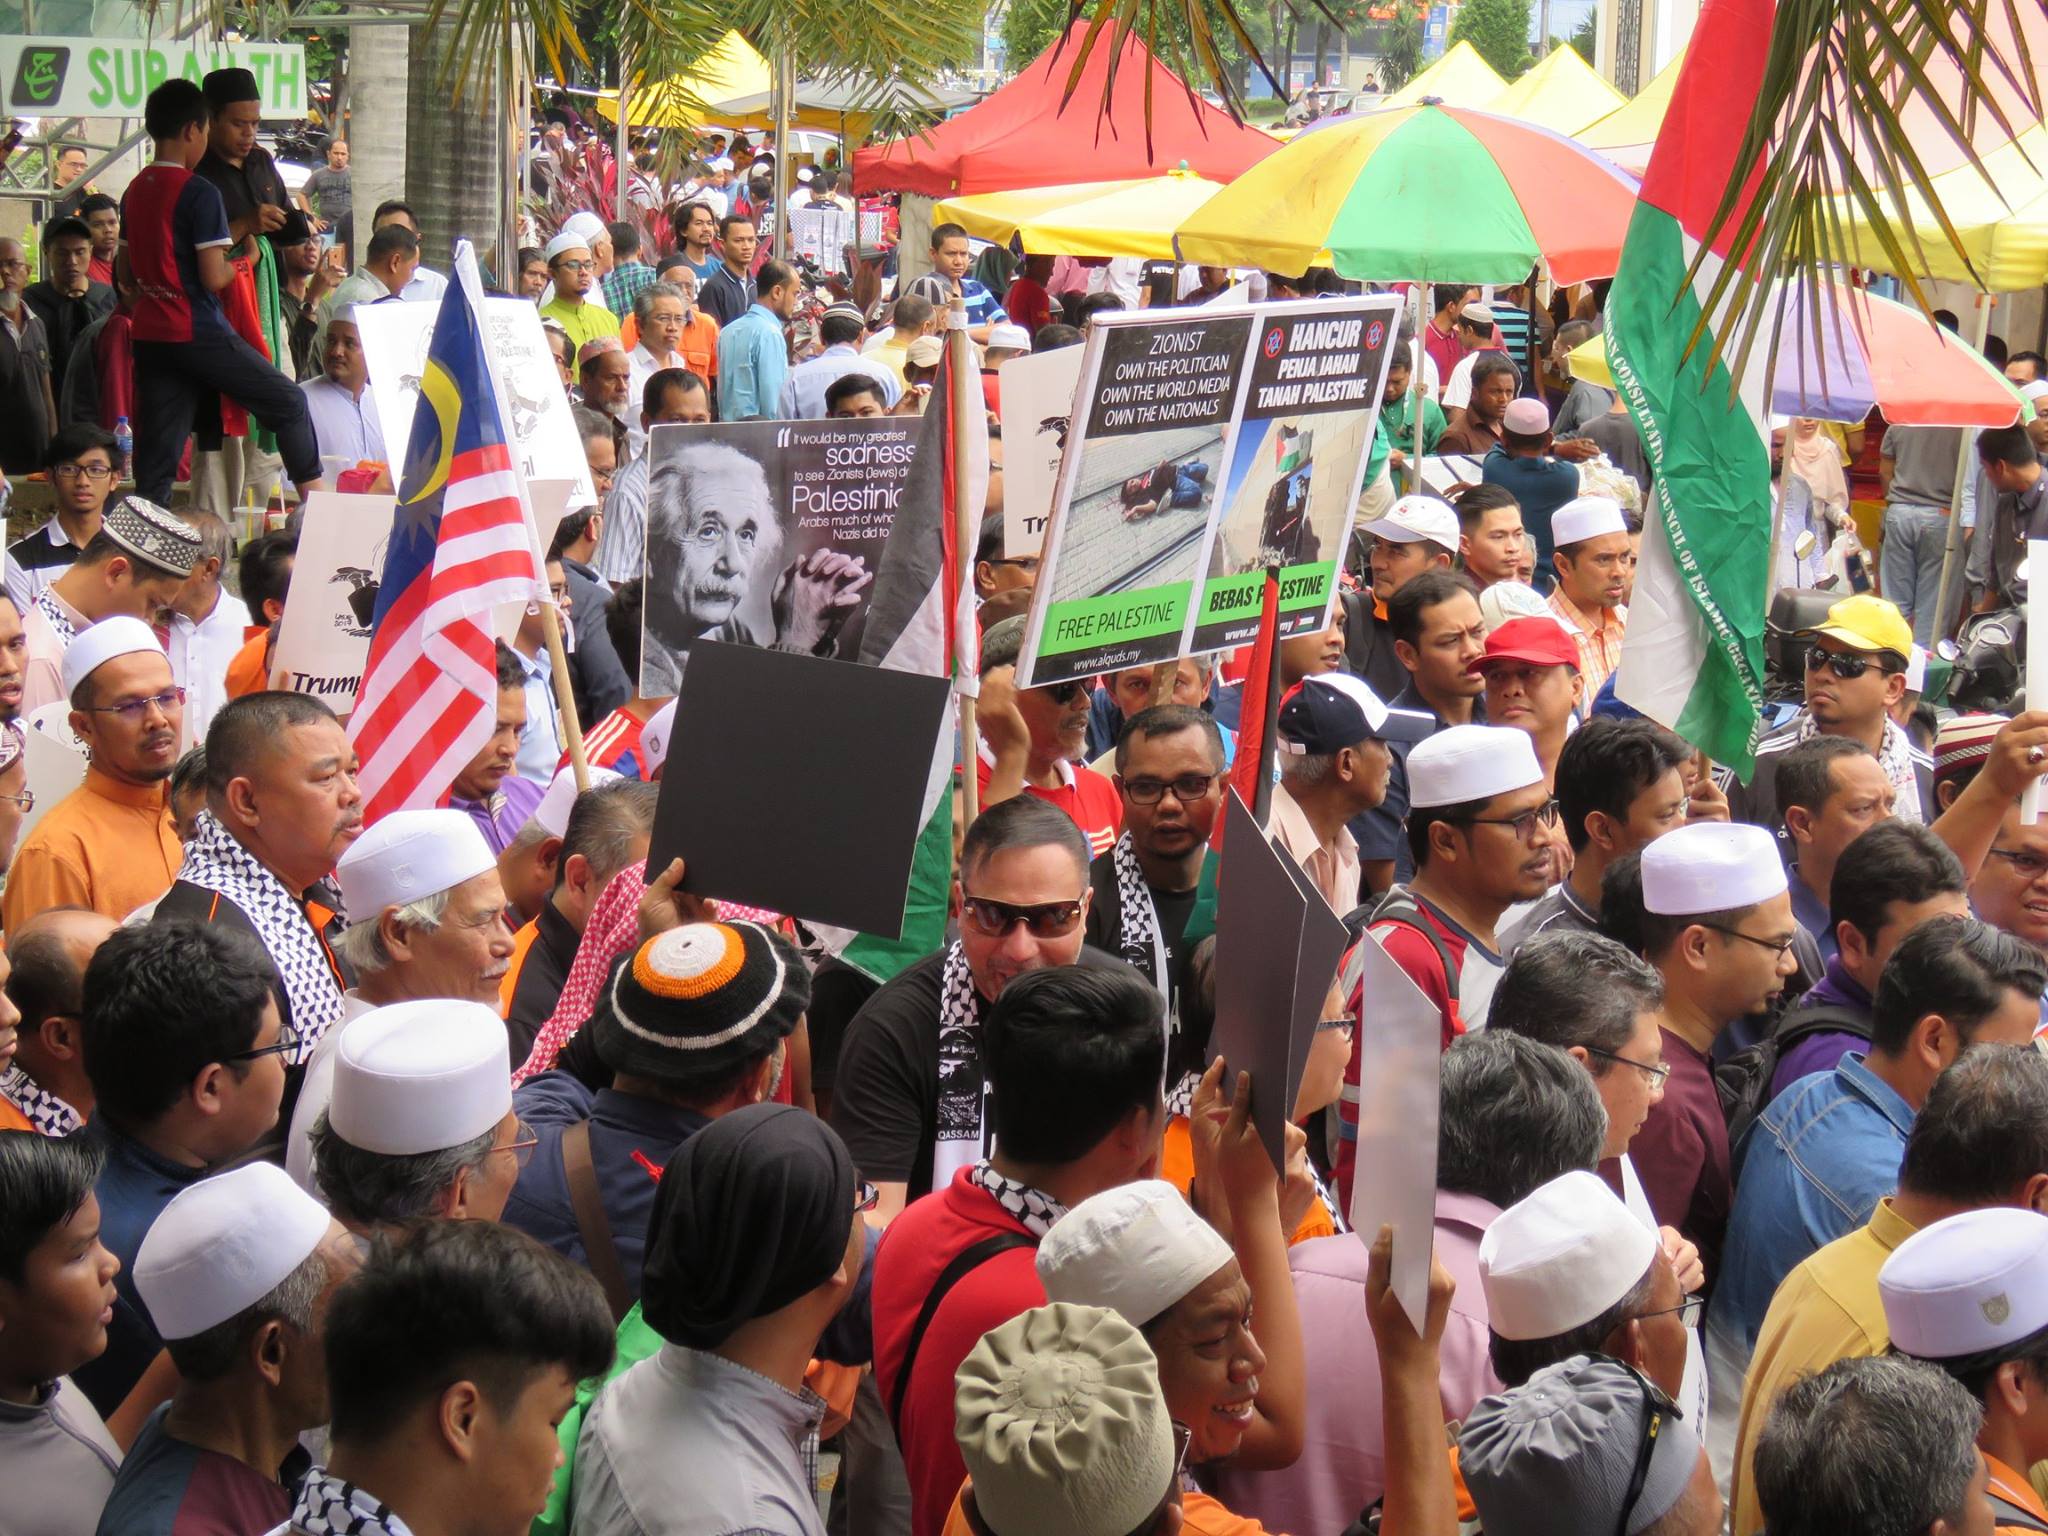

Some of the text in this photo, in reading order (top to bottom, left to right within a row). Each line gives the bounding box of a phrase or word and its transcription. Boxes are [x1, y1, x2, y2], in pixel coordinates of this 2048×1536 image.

[250, 52, 299, 110] TH
[1149, 331, 1206, 355] ZIONIST
[1288, 320, 1363, 352] HANCUR
[1116, 354, 1230, 381] OWN THE POLITICIAN
[1101, 376, 1231, 405] OWN THE WORLD MEDIA
[1258, 378, 1368, 409] TANAH PALESTINE
[1105, 408, 1135, 427] OWN
[1137, 405, 1158, 423] THE
[800, 432, 831, 444] would
[833, 431, 846, 443] be
[849, 433, 864, 446] my
[867, 431, 906, 444] greatest
[826, 442, 916, 466] sadness
[794, 471, 803, 482] to
[805, 471, 824, 482] see
[827, 468, 864, 481] Zionists
[866, 466, 897, 480] (Jews)
[798, 516, 829, 528] Arabs
[831, 515, 859, 526] much
[861, 513, 871, 524] of
[1658, 478, 1686, 550] COUNCIL
[833, 528, 889, 541] Nazis did to
[1679, 550, 1698, 573] OF
[1209, 575, 1325, 613] BEBAS PESTINE
[1688, 573, 1734, 641] ISLAMIC
[1056, 600, 1175, 641] FREE PALESTINE
[1073, 649, 1142, 672] www.alquds.my
[938, 1129, 980, 1140] QASSAM
